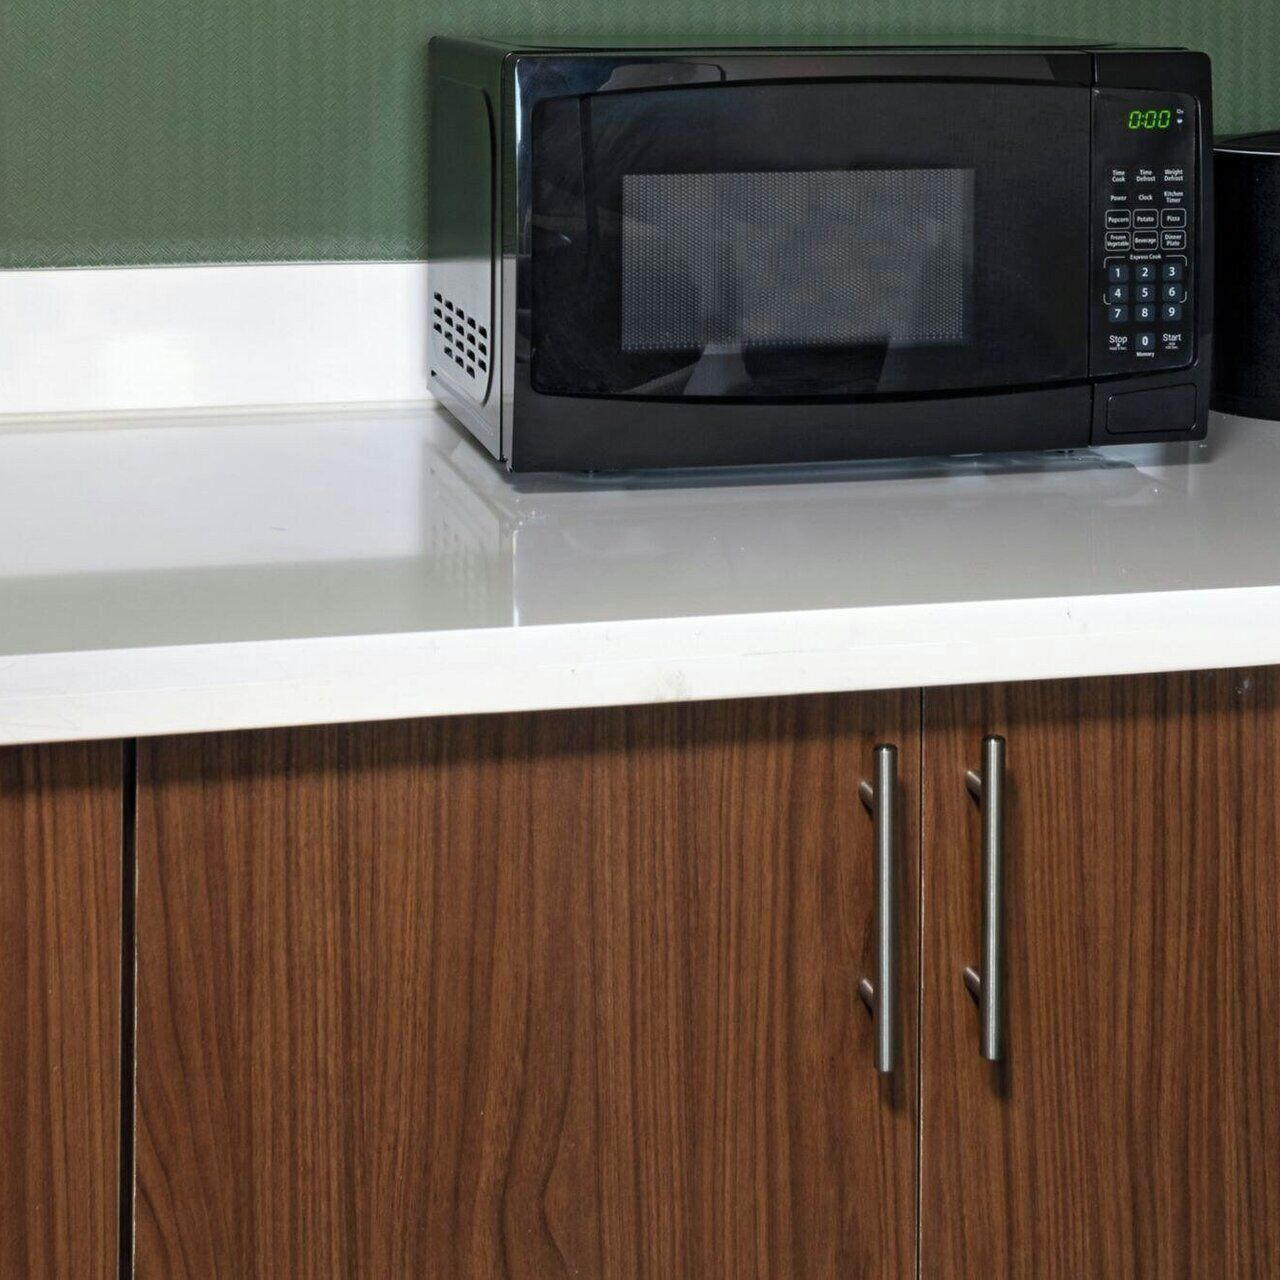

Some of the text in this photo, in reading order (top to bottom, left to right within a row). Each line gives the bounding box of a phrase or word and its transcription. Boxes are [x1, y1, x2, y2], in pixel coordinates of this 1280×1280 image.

[1128, 110, 1171, 129] 0:00
[1108, 216, 1129, 224] Popcorn
[1115, 268, 1120, 278] 1
[1142, 267, 1149, 277] 2
[1169, 266, 1176, 276] 3
[1114, 288, 1121, 297] 4
[1142, 287, 1148, 297] 5
[1168, 286, 1176, 297] 6
[1114, 308, 1121, 318] 7
[1141, 308, 1149, 317] 8
[1168, 307, 1175, 317] 9
[1109, 335, 1128, 345] Stop
[1142, 335, 1149, 346] 0
[1163, 333, 1182, 342] Start
